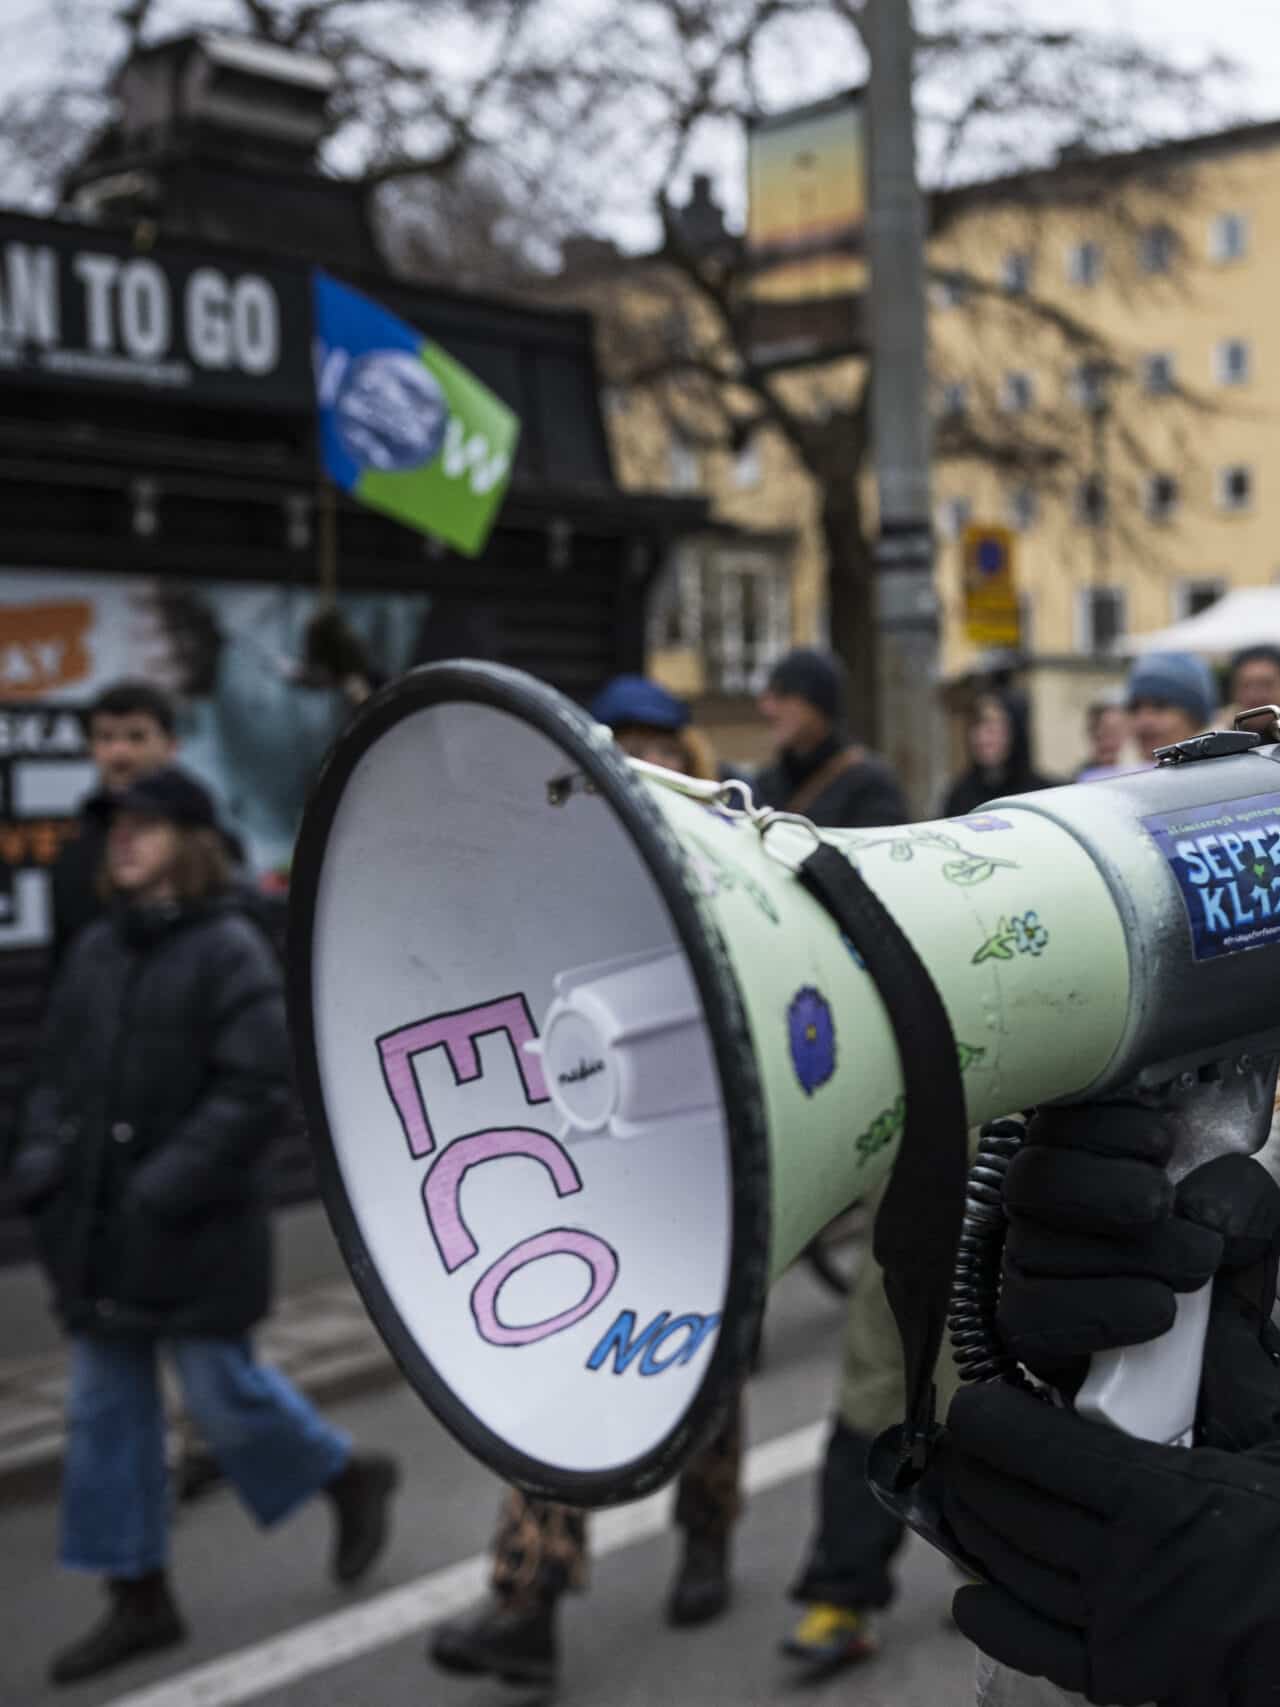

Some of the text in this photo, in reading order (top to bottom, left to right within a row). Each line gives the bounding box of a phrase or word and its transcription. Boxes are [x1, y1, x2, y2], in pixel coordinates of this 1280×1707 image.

[74, 254, 171, 358] TO
[184, 265, 281, 376] GO
[376, 992, 619, 1347] ECO
